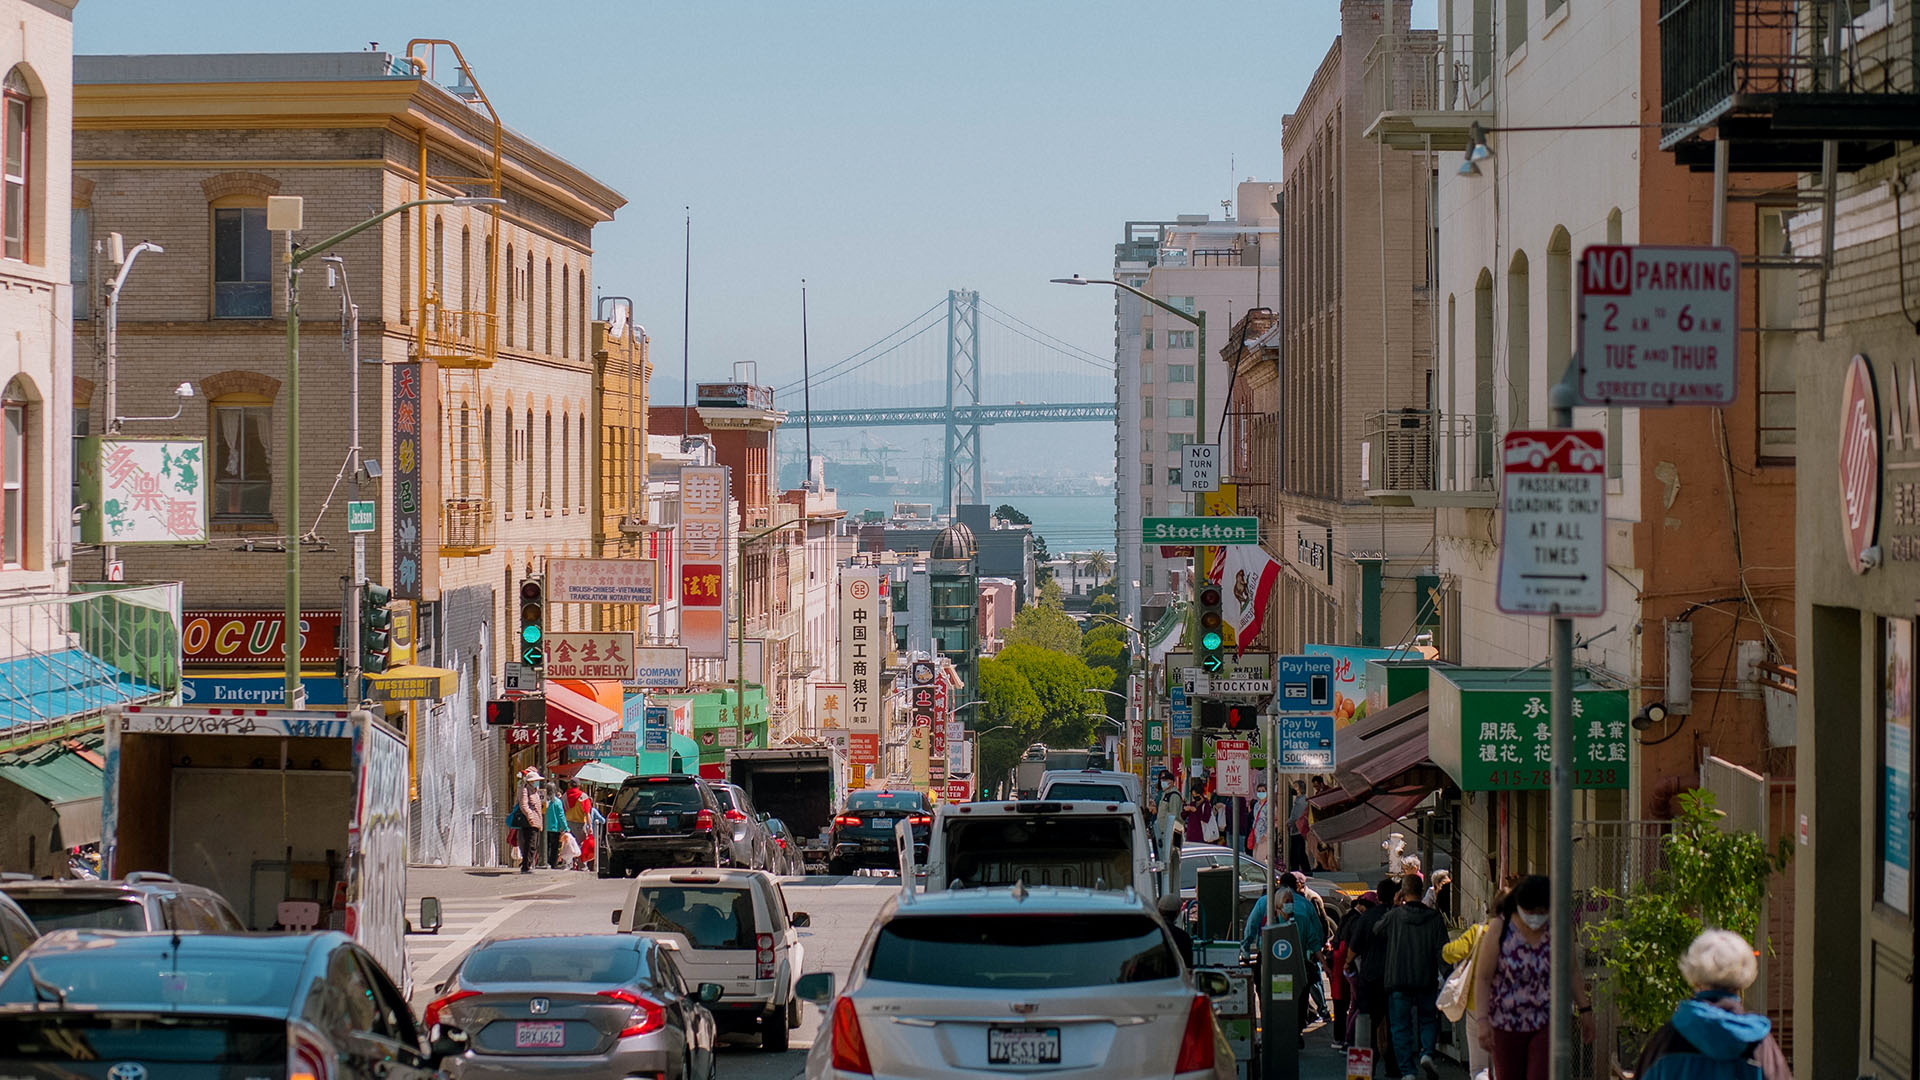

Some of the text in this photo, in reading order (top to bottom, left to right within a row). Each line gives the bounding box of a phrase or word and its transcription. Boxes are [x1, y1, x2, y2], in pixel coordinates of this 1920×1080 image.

[1588, 250, 1731, 292] NO PARKING
[1604, 303, 1619, 332] 2
[1677, 304, 1694, 332] 6
[1605, 344, 1718, 370] TUE AND THUR
[1596, 382, 1724, 399] STREET CLEANING
[1192, 449, 1211, 458] NO
[1190, 460, 1212, 468] TURN
[1194, 471, 1207, 479] ON
[1192, 481, 1209, 489] RED
[1518, 478, 1590, 493] PASSENGER
[1508, 499, 1599, 514] LOADING ONLY
[351, 510, 373, 525] Jackson
[1155, 524, 1245, 538] Stockton
[1529, 522, 1583, 540] AT ALL
[1534, 546, 1579, 564] TIMES
[853, 607, 868, 713] 中国工商银行
[548, 665, 629, 676] SUNG JEWELRY
[640, 668, 682, 677] COMPANY
[1281, 661, 1331, 674] Pay here
[375, 680, 424, 690] WESTERN
[646, 678, 679, 686] GINSENG
[1210, 682, 1269, 691] STOCKTON
[390, 689, 424, 698] UNION
[1282, 719, 1318, 730] Pay by
[1282, 730, 1321, 739] License
[1282, 740, 1310, 749] Plate
[1217, 749, 1227, 760] NO
[1226, 765, 1240, 773] ANY
[1225, 775, 1241, 783] TIME
